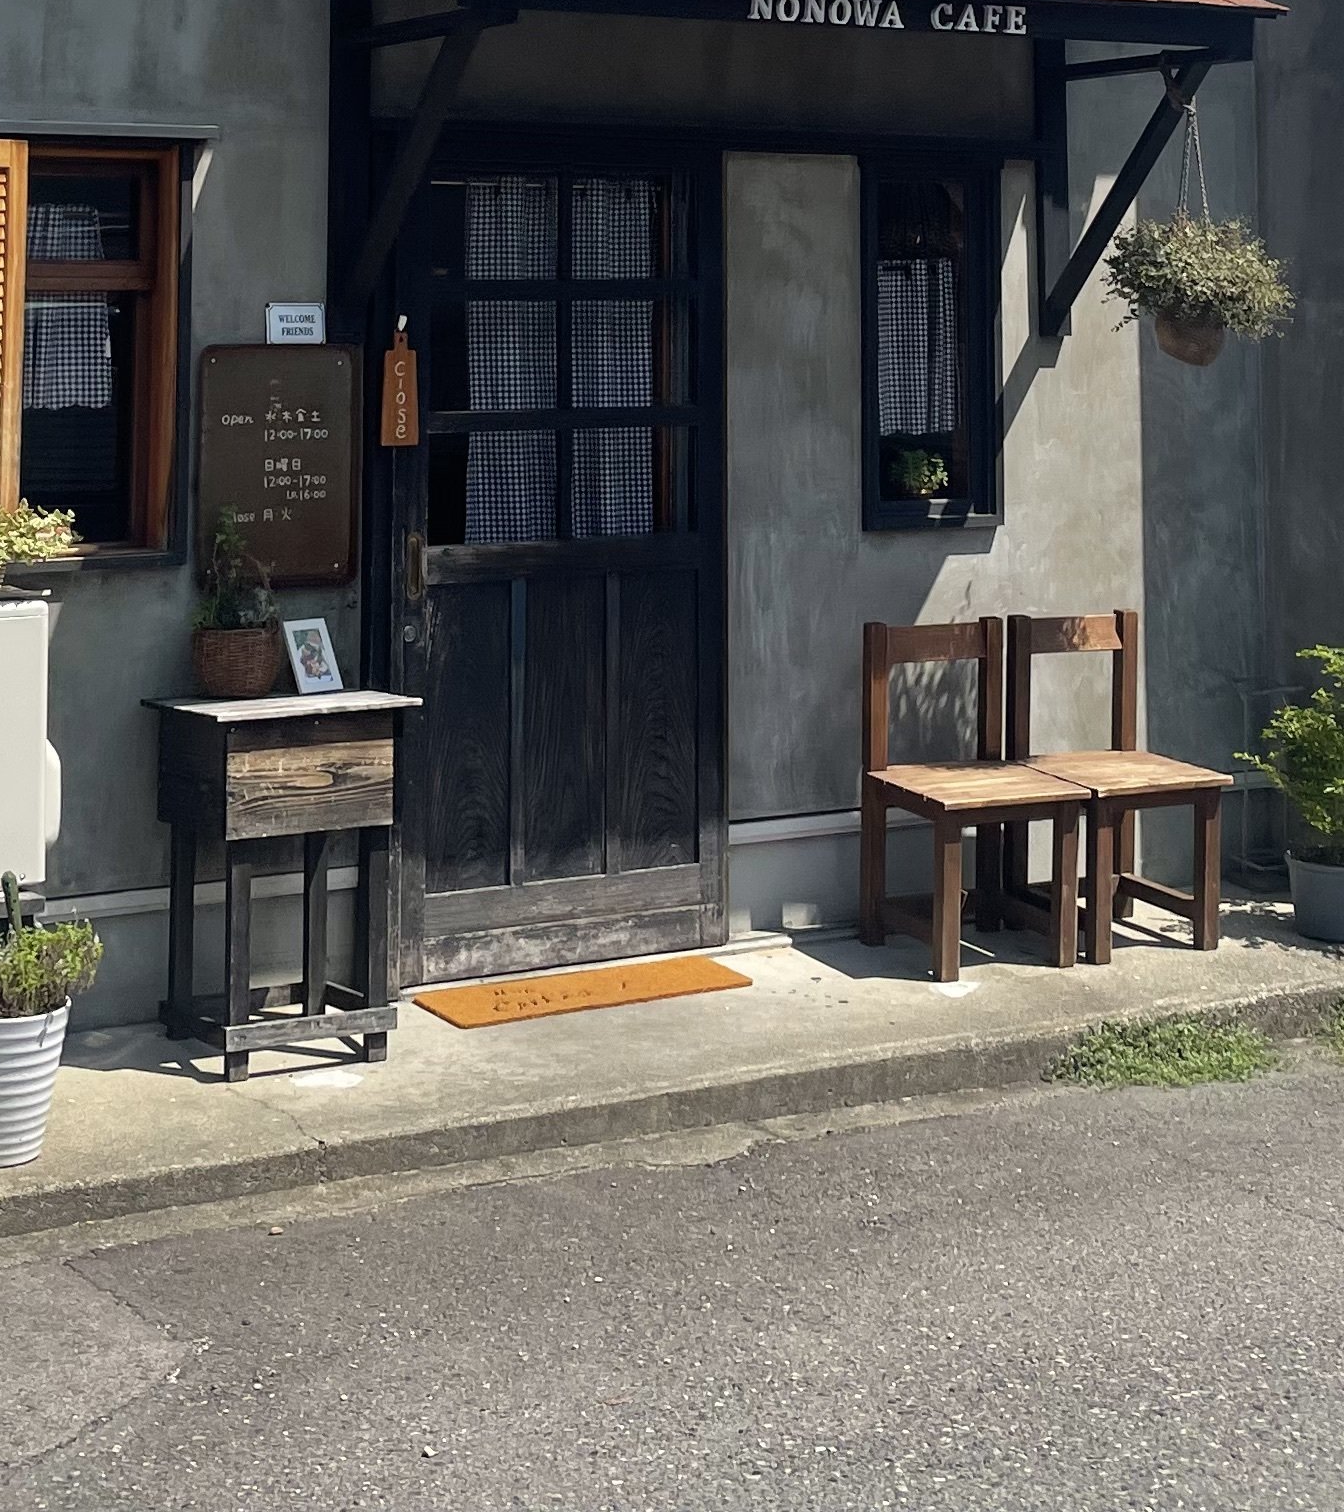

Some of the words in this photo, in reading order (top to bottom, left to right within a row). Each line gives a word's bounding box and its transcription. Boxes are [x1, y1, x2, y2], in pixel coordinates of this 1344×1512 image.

[930, 3, 1027, 35] CAFE
[278, 314, 316, 324] WELCOME
[281, 326, 314, 336] FRIENDS
[264, 457, 301, 472] 日曜日
[231, 511, 256, 524] lose
